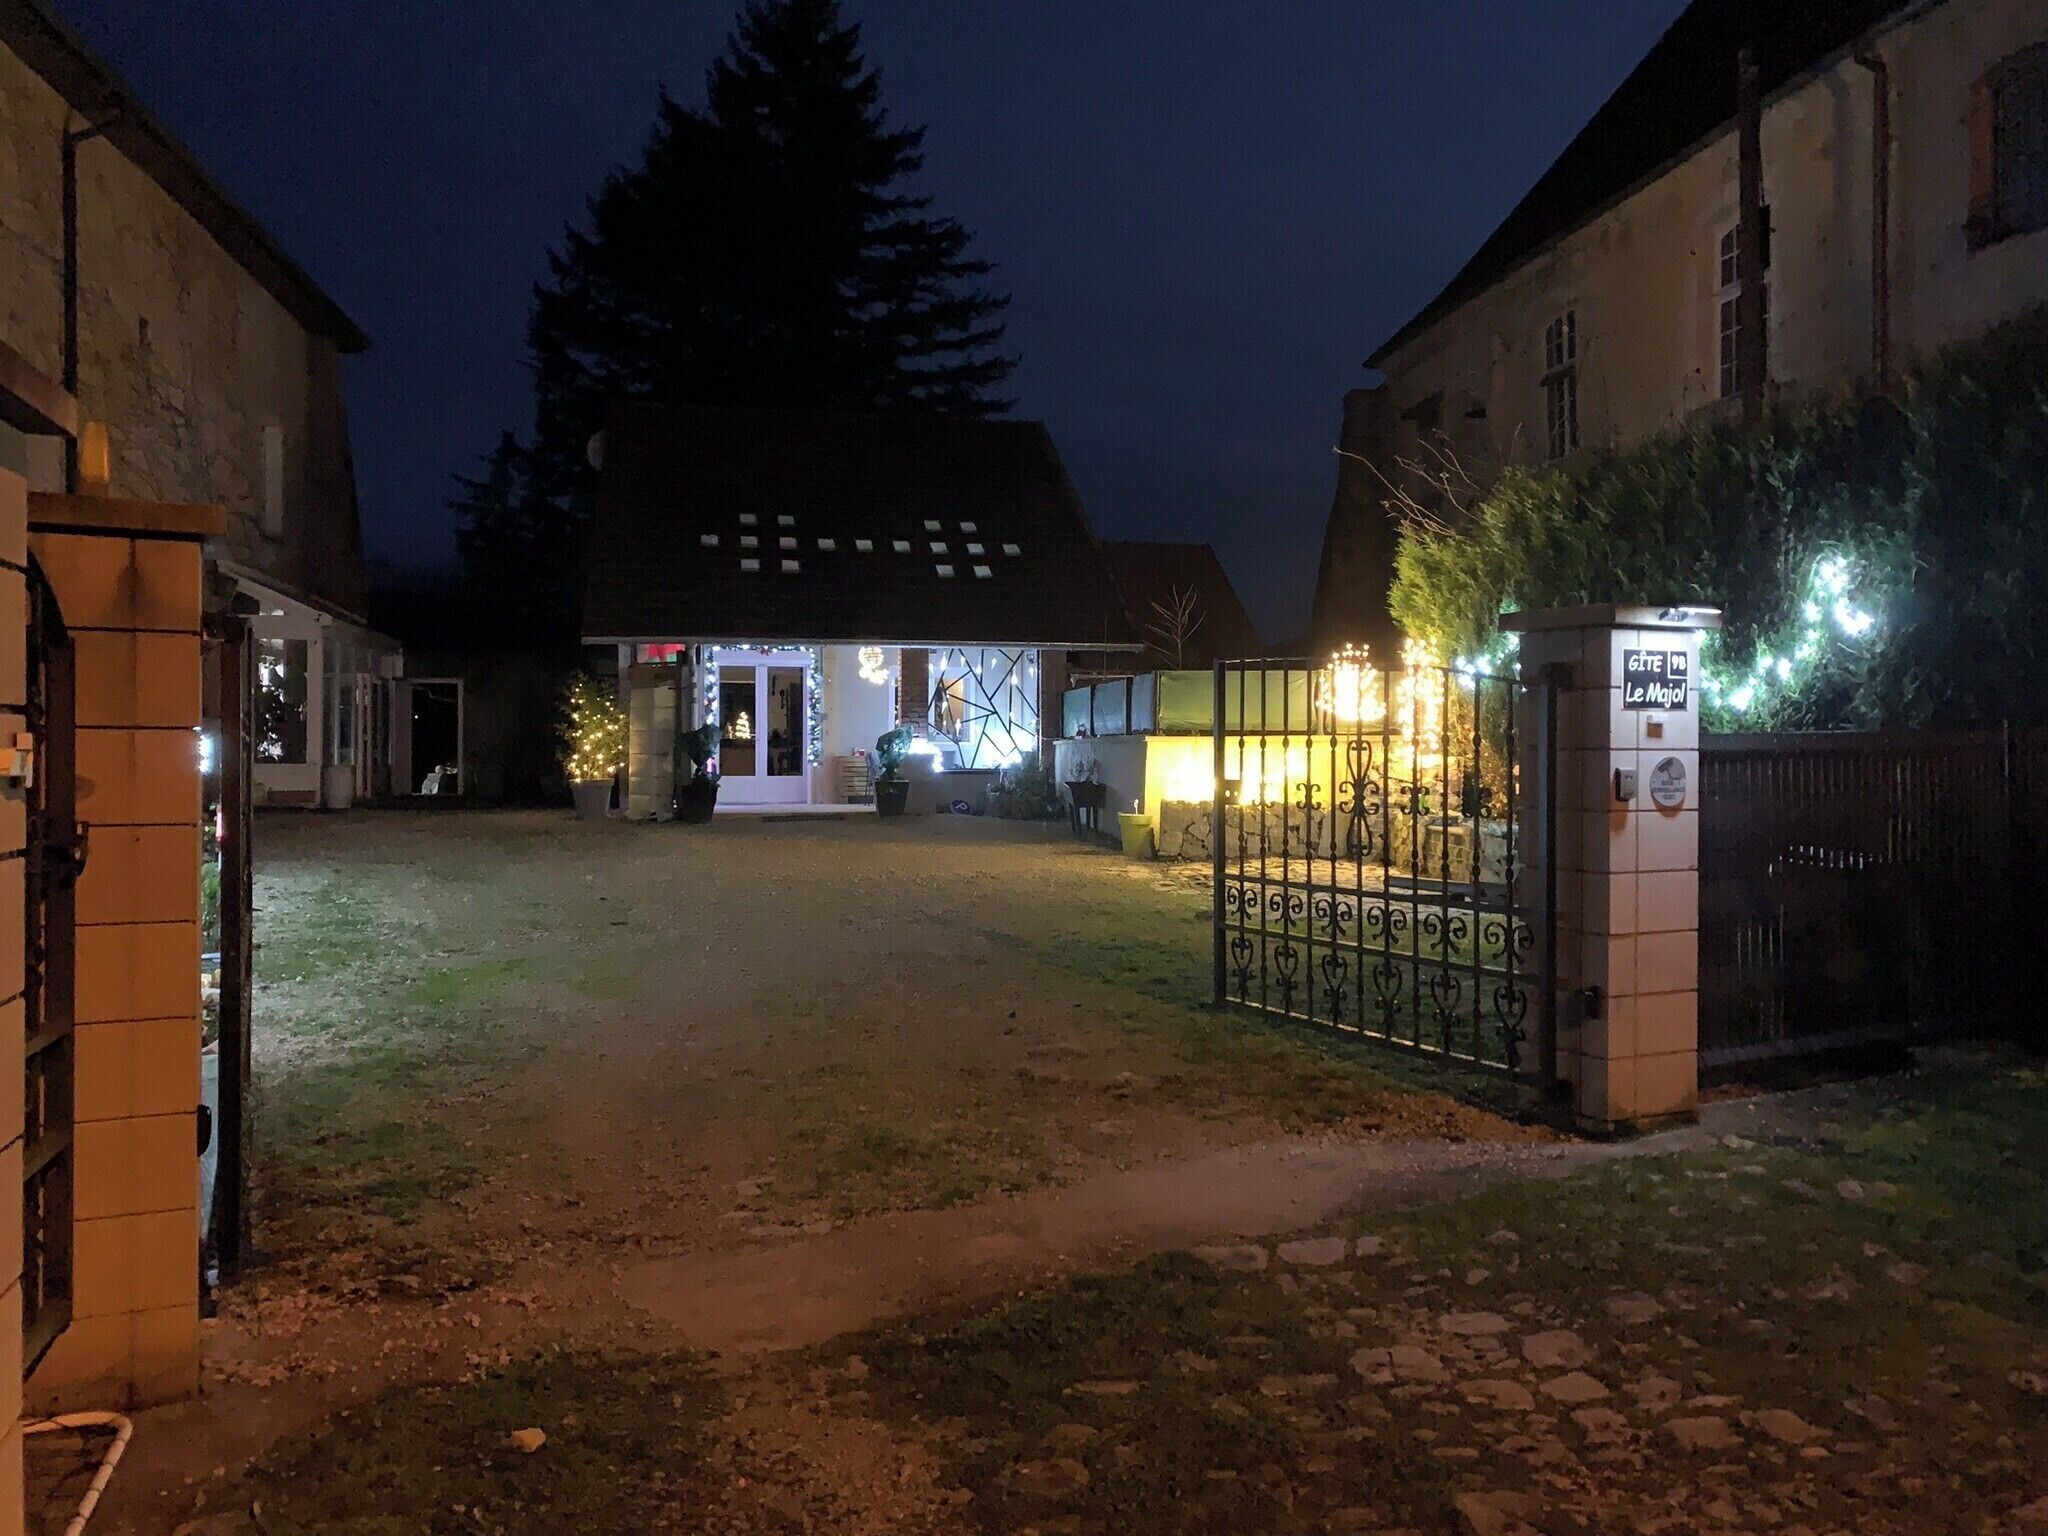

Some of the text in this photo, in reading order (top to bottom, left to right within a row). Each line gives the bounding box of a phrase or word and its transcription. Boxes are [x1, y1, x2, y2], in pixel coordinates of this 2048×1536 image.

[1628, 650, 1663, 672] GÎTE
[1625, 681, 1686, 708] Le Majol
